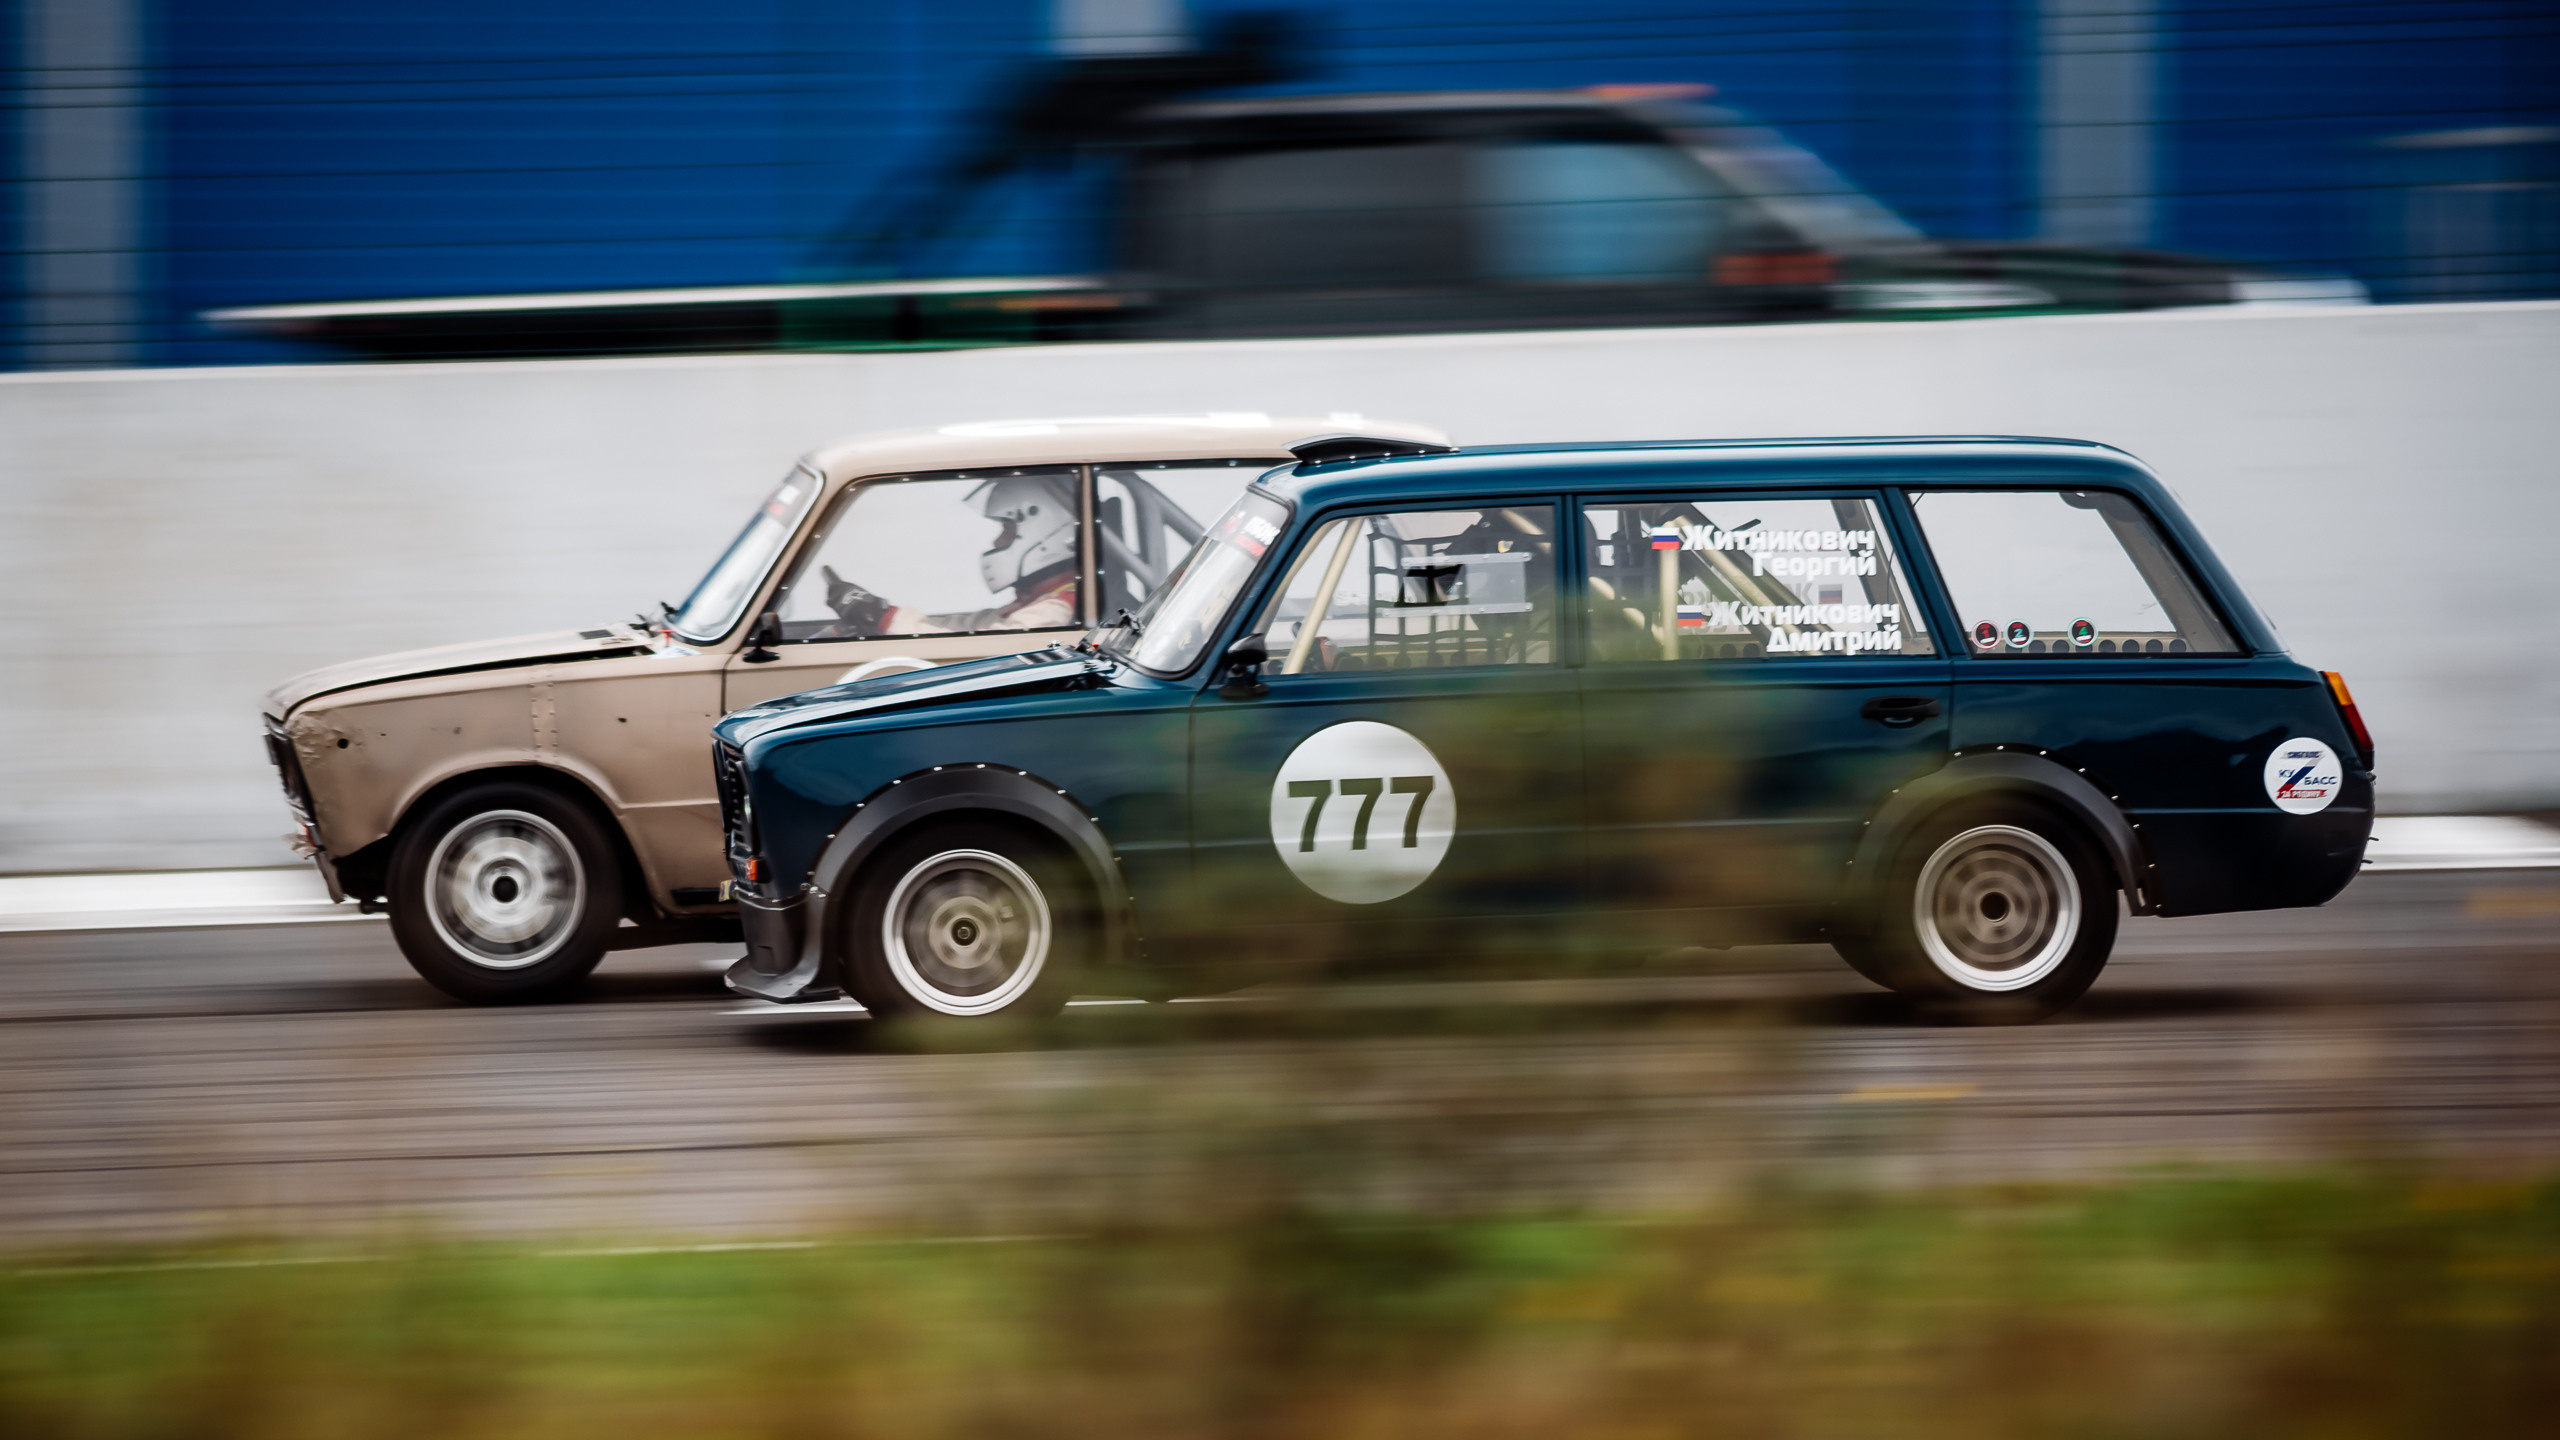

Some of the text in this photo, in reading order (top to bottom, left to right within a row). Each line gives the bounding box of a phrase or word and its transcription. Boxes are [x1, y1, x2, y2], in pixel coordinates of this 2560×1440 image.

[1681, 525, 1875, 551] Житникович
[1752, 549, 1877, 580] Георгий
[1708, 601, 1900, 626] Житникович
[1766, 625, 1902, 656] Дмитрий
[2013, 628, 2024, 638] 2
[1287, 776, 1435, 852] 777
